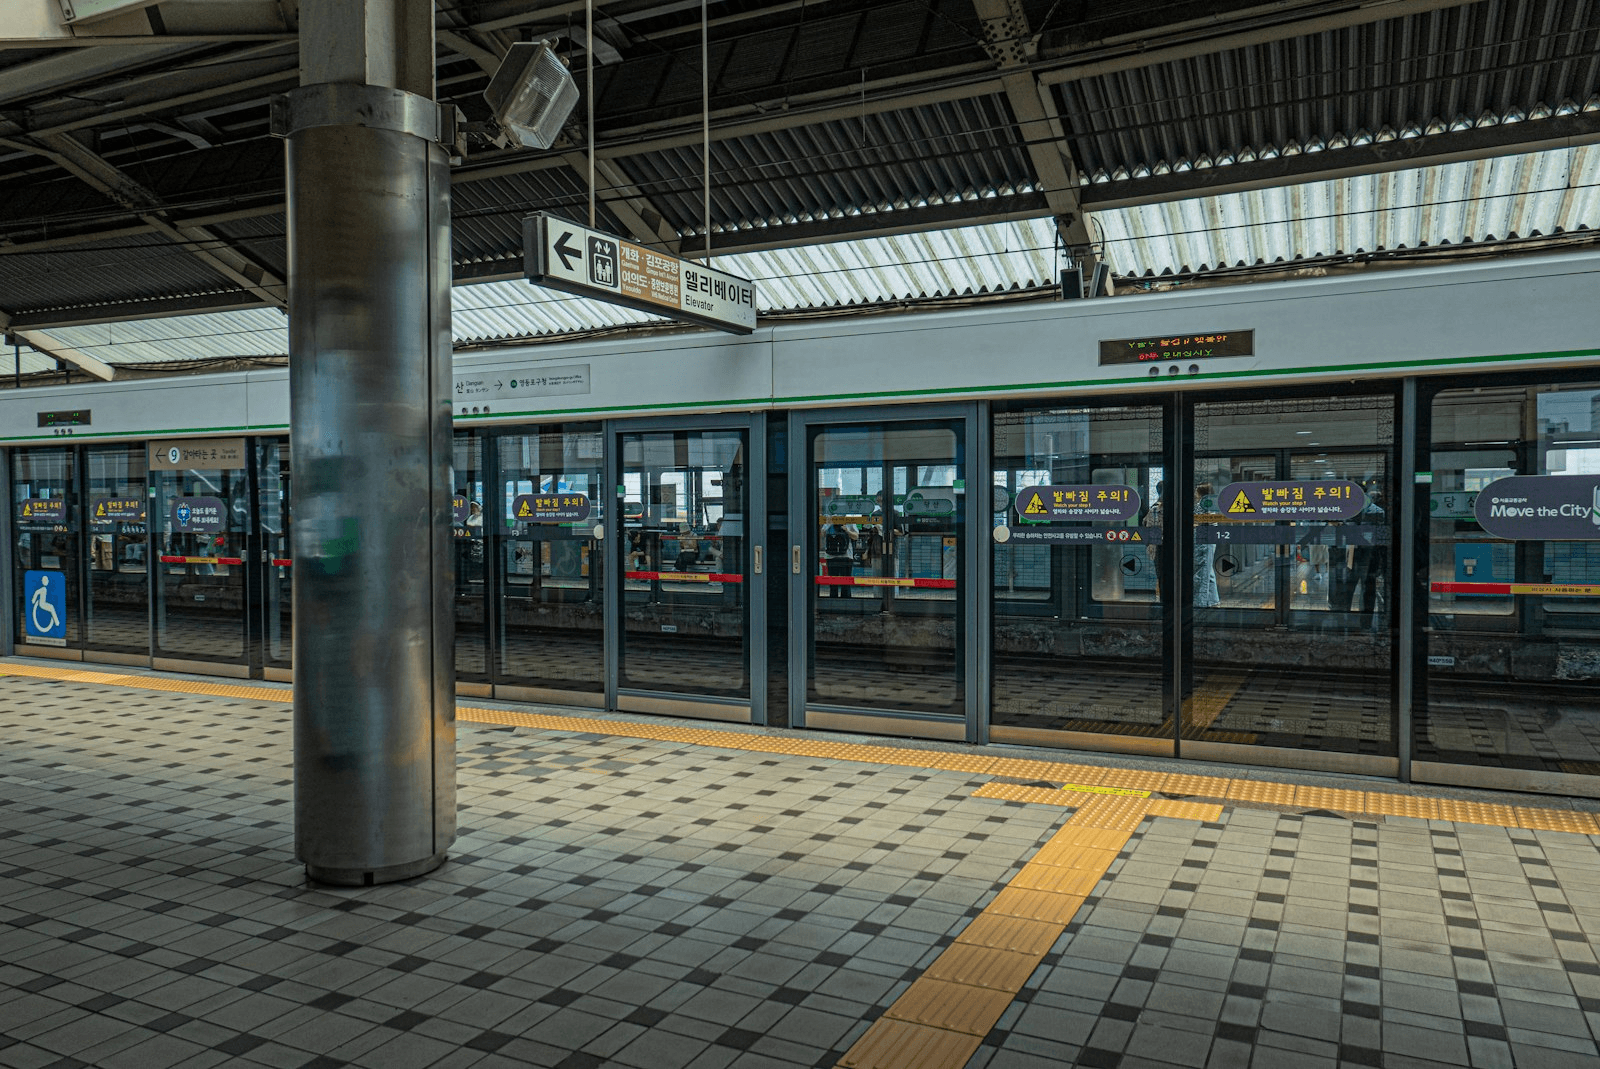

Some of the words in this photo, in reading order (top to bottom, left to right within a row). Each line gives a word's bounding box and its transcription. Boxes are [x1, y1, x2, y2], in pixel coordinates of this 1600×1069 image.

[621, 246, 639, 262] 개화
[646, 254, 679, 274] 김포공항
[622, 270, 648, 288] 여의도
[685, 270, 753, 308] 엘리베이터
[685, 295, 714, 311] Elevator
[455, 381, 464, 394] 산
[519, 377, 547, 388] 영등포구청
[171, 449, 177, 461] 9
[183, 449, 208, 461] 갈아타는
[211, 449, 218, 460] 곳
[1053, 490, 1089, 503] 발빠짐
[1096, 489, 1129, 502] 주의!
[1261, 487, 1304, 501] 발빠짐
[1313, 486, 1351, 500] 주의!
[453, 499, 464, 508] 의!
[1490, 505, 1535, 518] Move
[1537, 506, 1558, 517] the
[1559, 504, 1592, 519] City
[1216, 531, 1231, 539] 1-2
